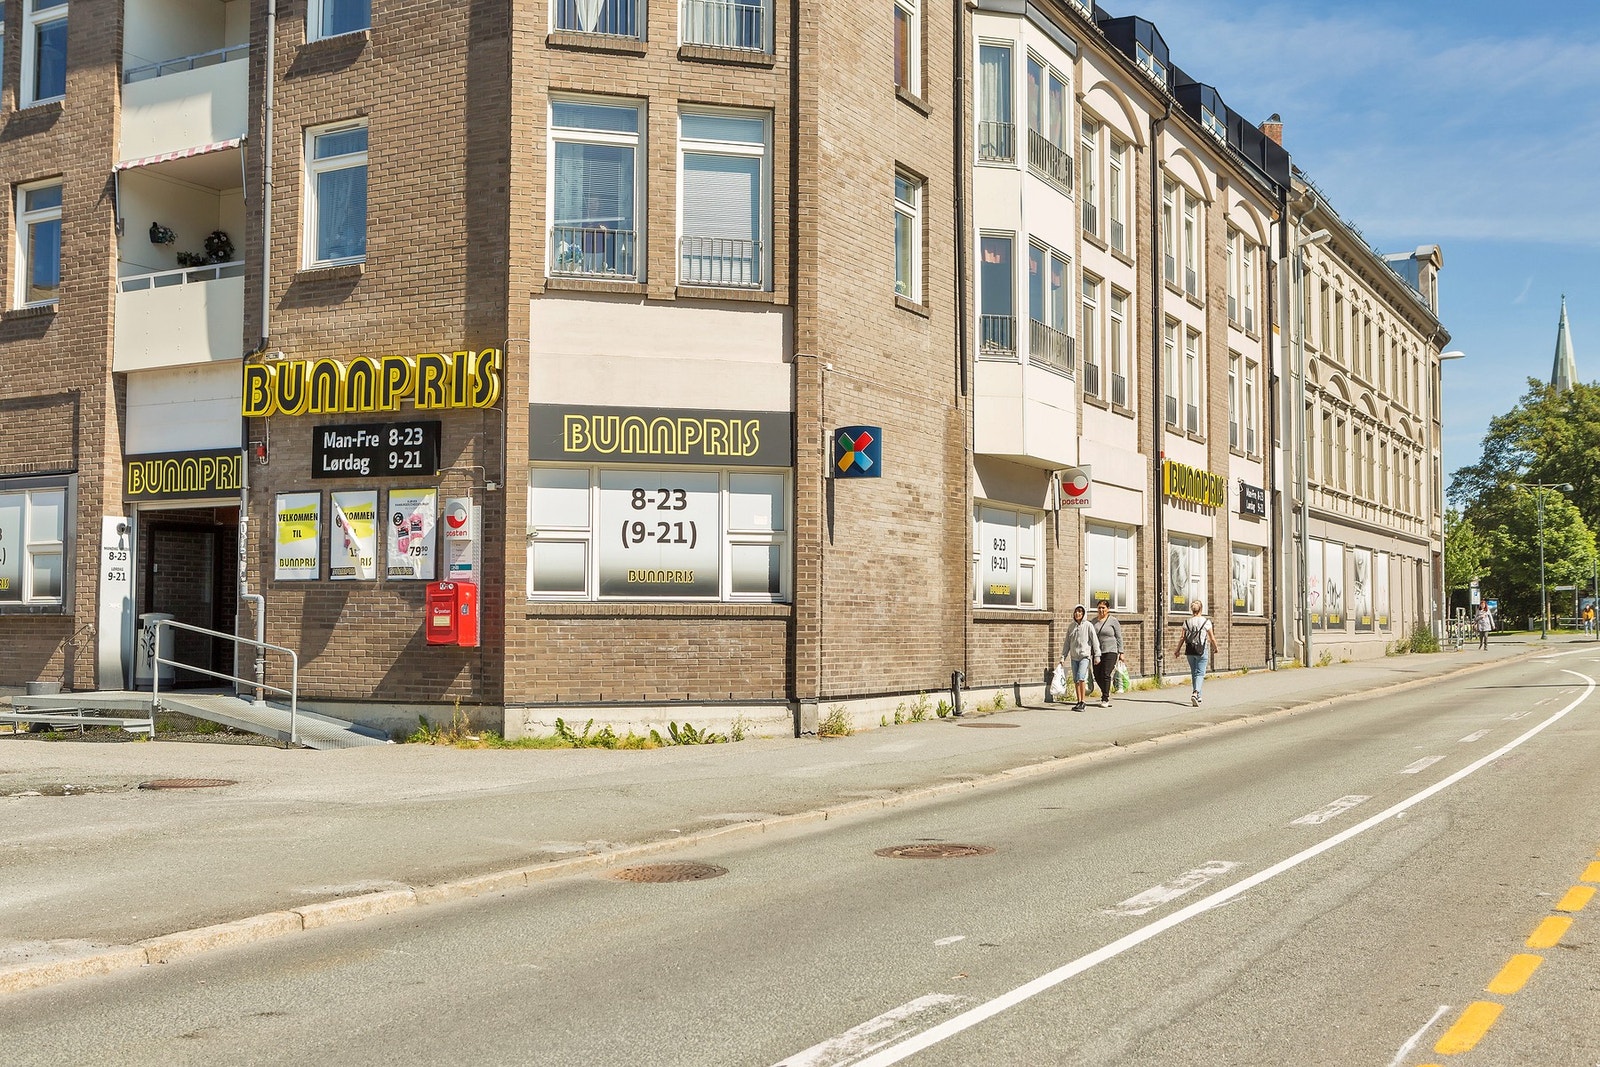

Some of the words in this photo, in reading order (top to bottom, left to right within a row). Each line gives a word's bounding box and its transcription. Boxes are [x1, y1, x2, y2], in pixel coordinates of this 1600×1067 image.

[241, 348, 502, 417] BUNNPRIS
[323, 430, 380, 449] Man-Fre
[388, 427, 423, 446] 8-23
[564, 414, 760, 457] BUNNPRIS
[322, 452, 370, 475] Lørdag
[388, 450, 422, 469] 9-21
[127, 455, 242, 495] BUNNPRI
[630, 487, 688, 511] 8-23
[1061, 498, 1089, 506] posten
[278, 512, 318, 522] VELKOMMEN
[292, 530, 302, 538] TIL
[446, 529, 468, 538] posten
[621, 520, 698, 549] (9-21)
[993, 538, 1006, 551] 8-23
[108, 551, 127, 561] 8-23
[279, 558, 316, 568] BUNNPRIS
[991, 556, 1008, 573] (9-21)
[108, 572, 126, 581] 9-21
[628, 570, 695, 584] BUNNPRIS
